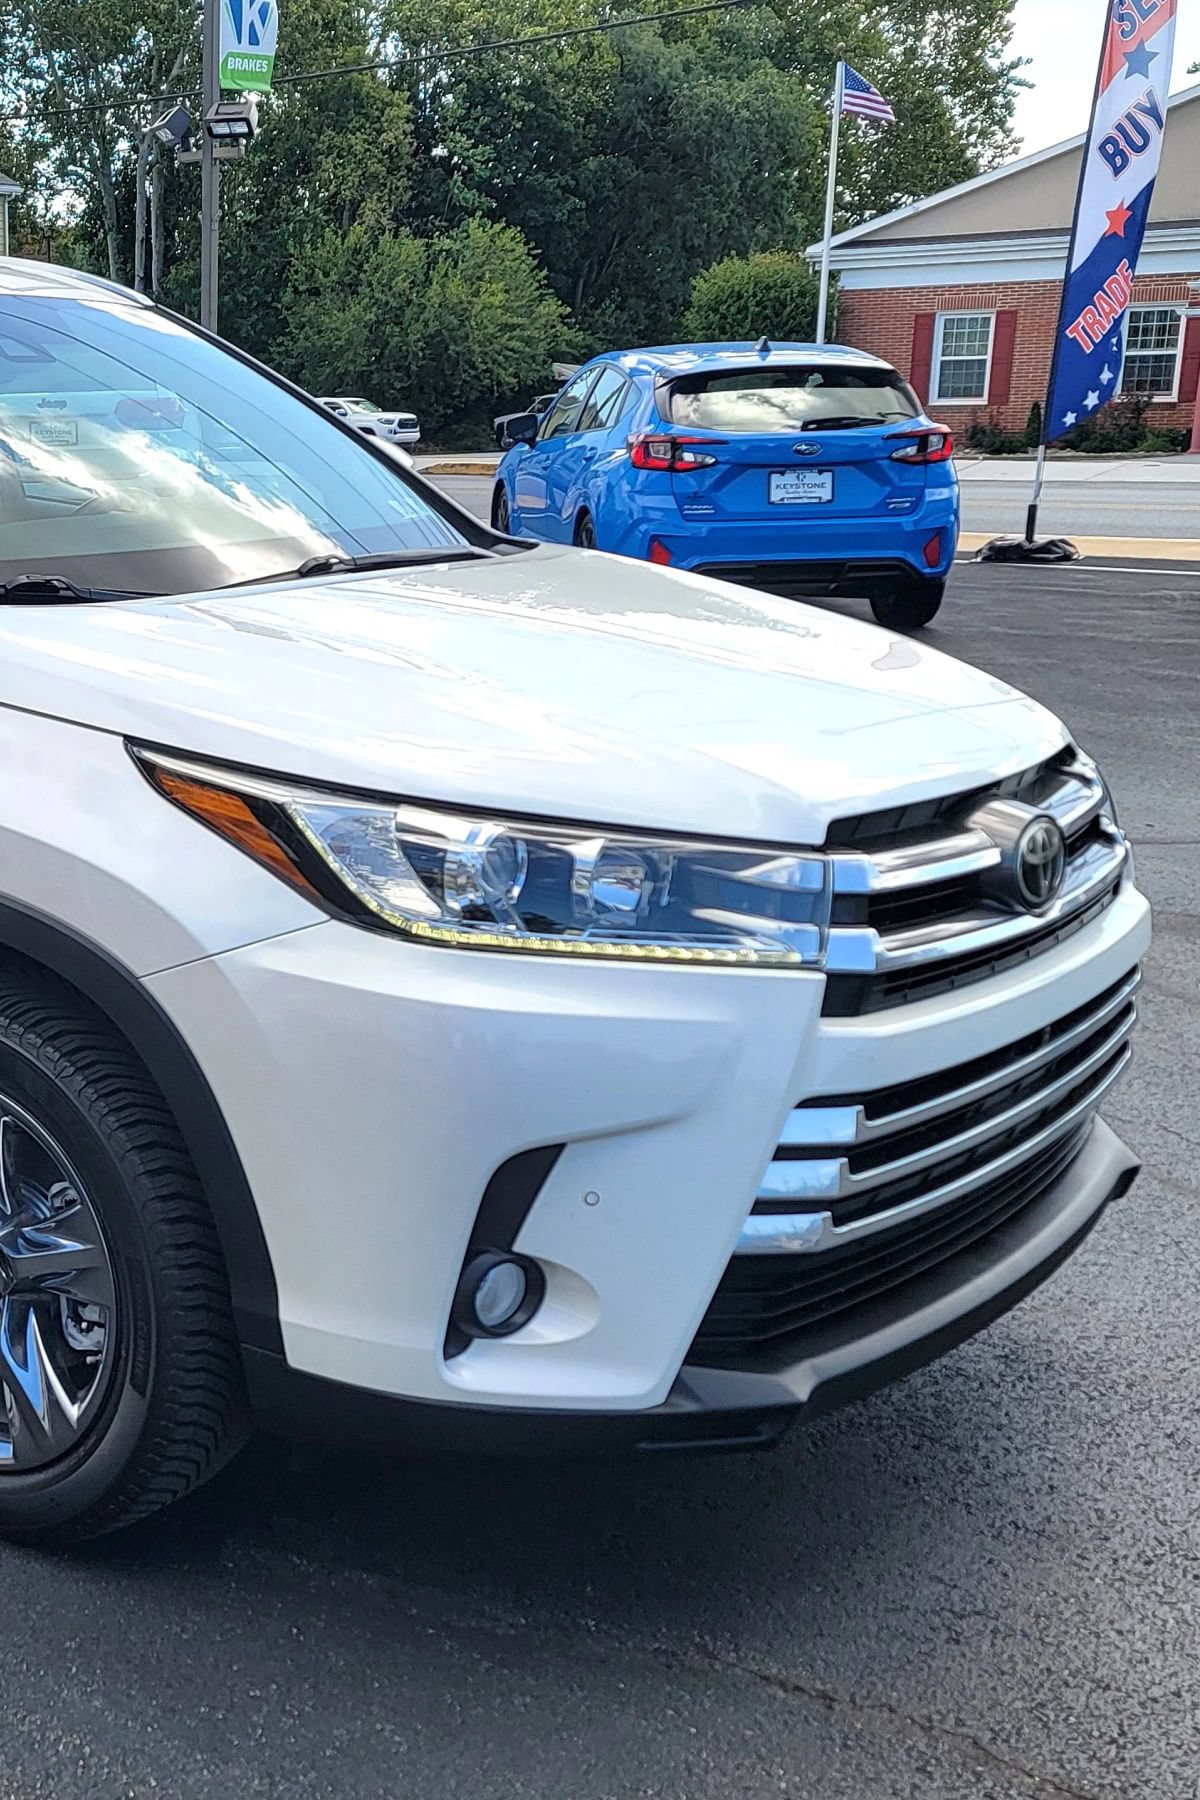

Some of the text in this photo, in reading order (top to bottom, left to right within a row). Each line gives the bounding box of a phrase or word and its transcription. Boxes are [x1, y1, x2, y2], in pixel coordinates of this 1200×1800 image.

[227, 57, 269, 73] BRAKES
[1097, 86, 1165, 180] BUY
[37, 398, 67, 410] Jeep
[776, 482, 828, 490] KEYSTONE
